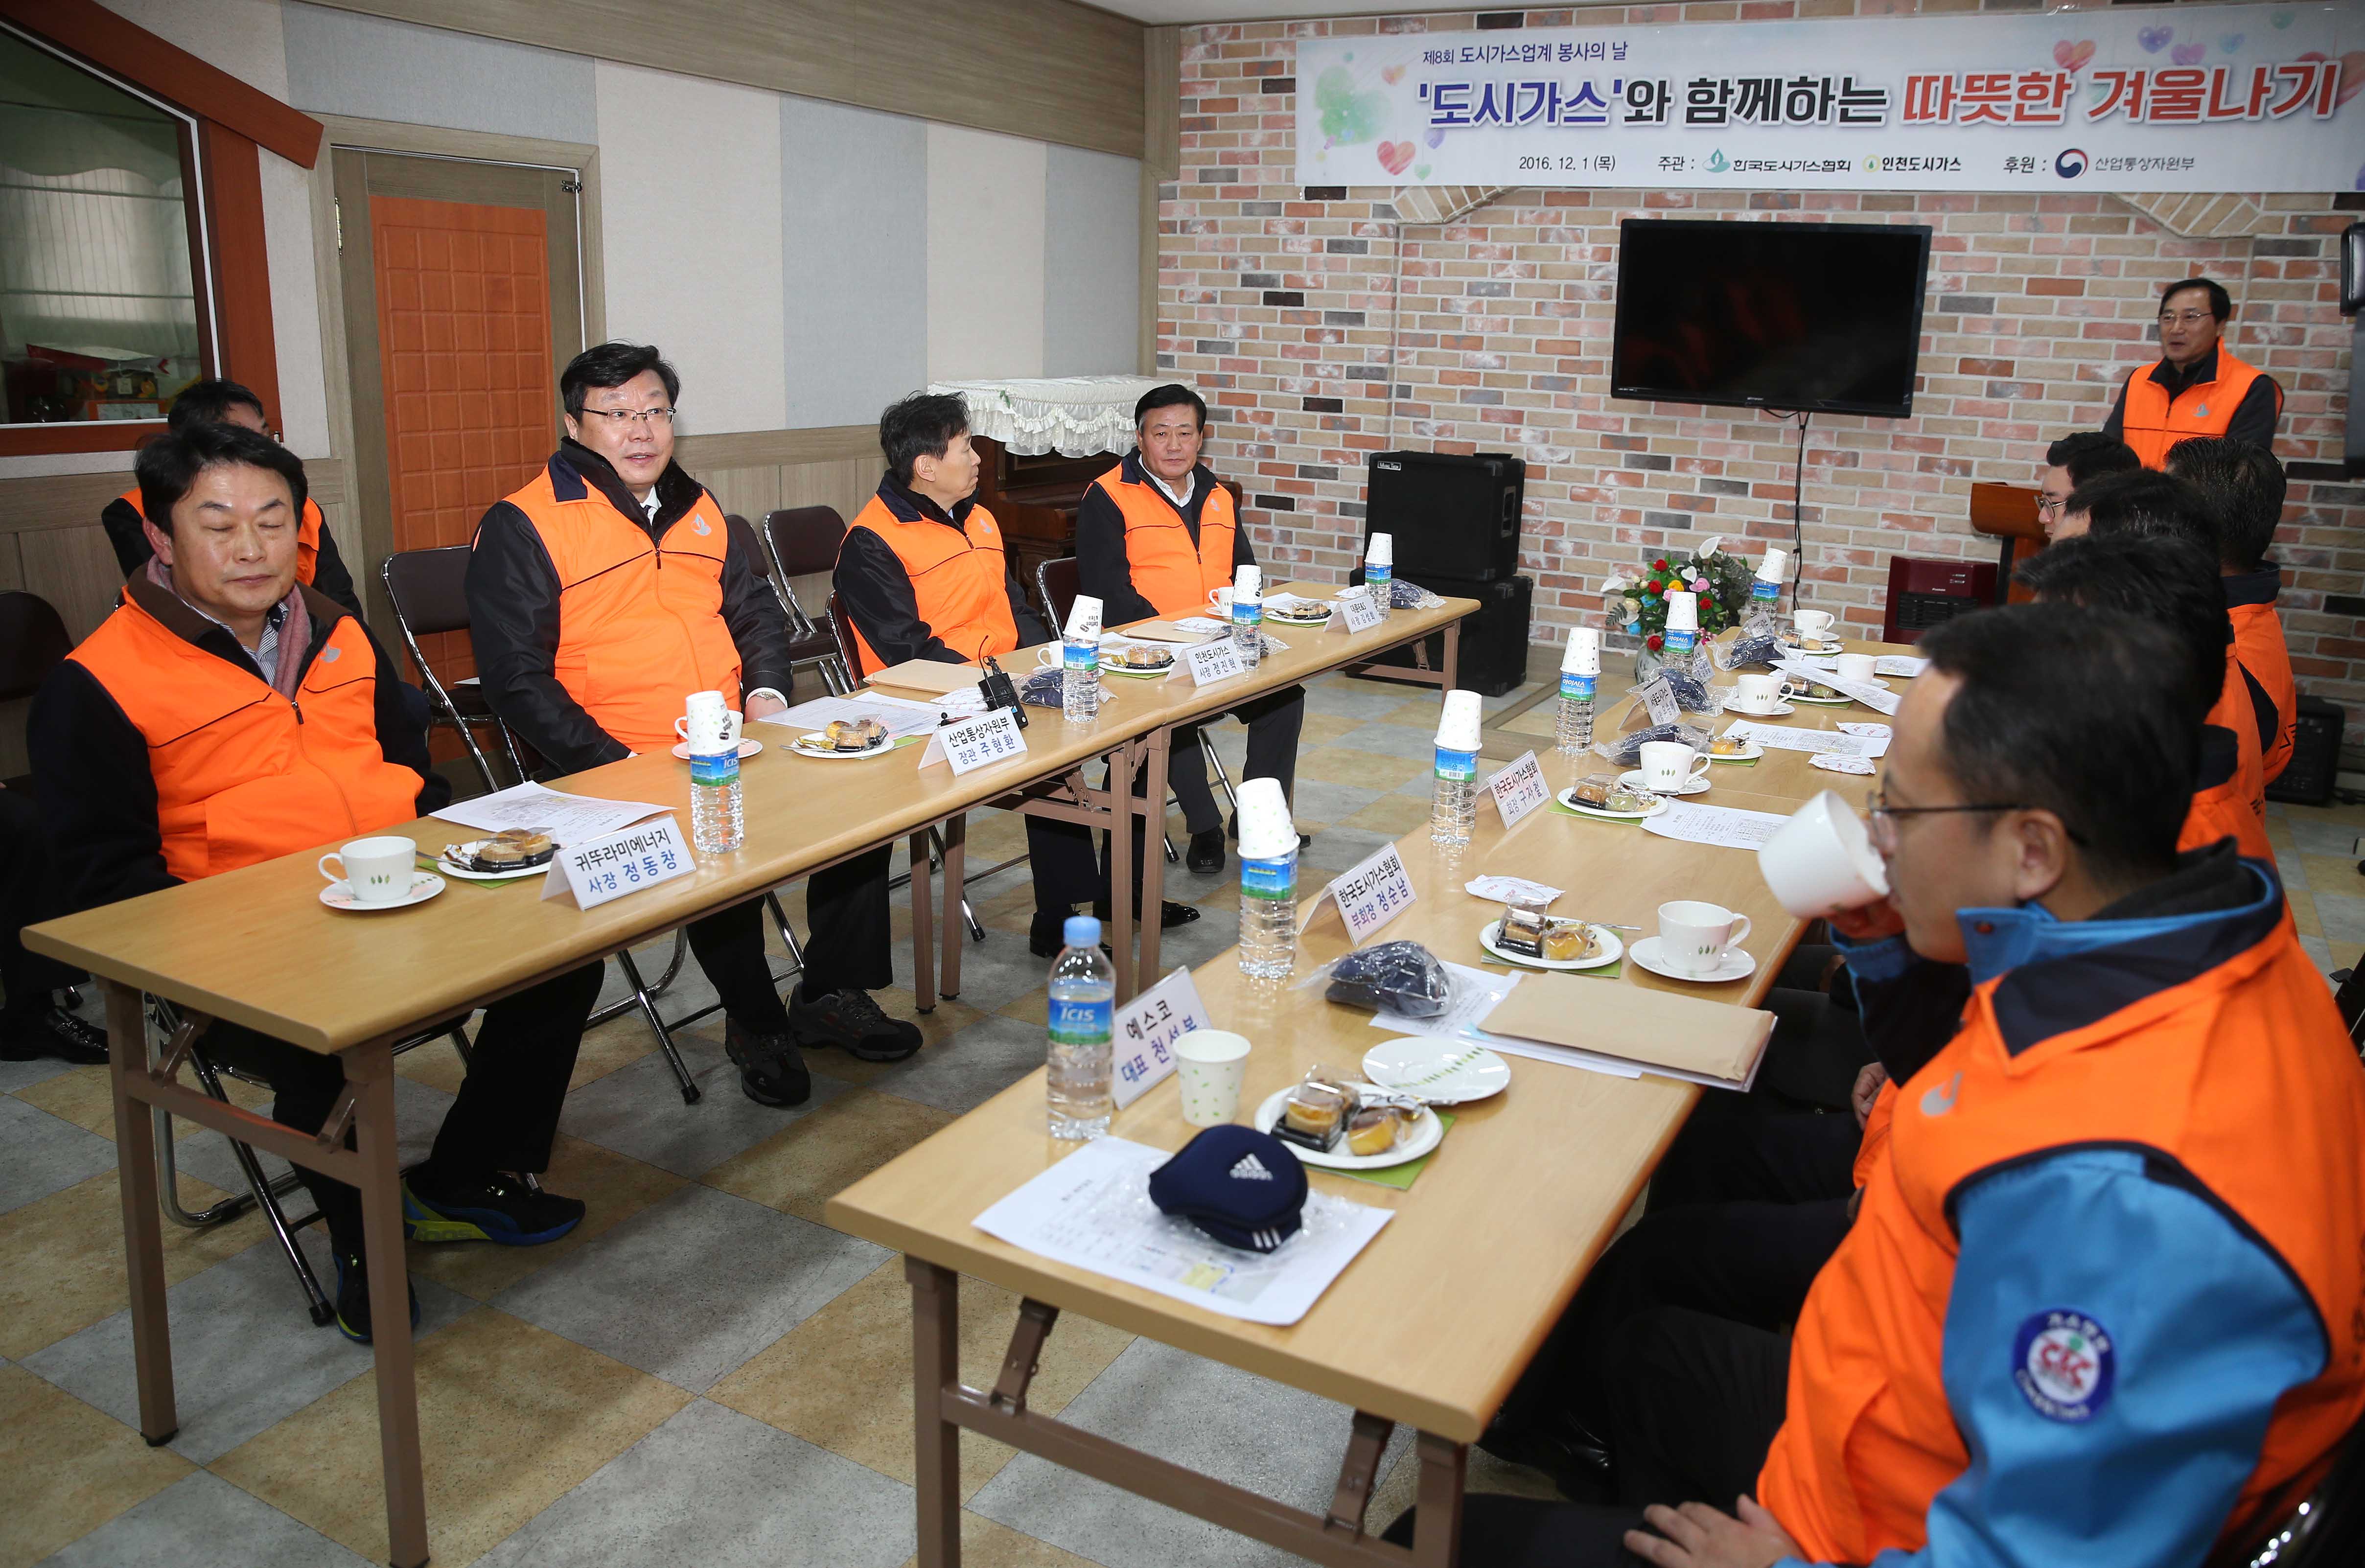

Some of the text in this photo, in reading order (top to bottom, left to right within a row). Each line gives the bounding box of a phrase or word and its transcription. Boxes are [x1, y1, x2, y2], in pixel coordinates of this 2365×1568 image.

[1422, 41, 1628, 65] 제8회 도시가스업계 봉사의 날
[1686, 76, 1887, 123] 함께하는
[1903, 71, 2072, 122] 따뜻한
[2087, 64, 2337, 120] 겨울나기
[1519, 156, 1553, 170] 2016.
[1558, 156, 1577, 171] 12.
[1593, 155, 1616, 172] (목)
[1733, 159, 1852, 172] 한국도시가스협회
[1881, 156, 1962, 172] 인천도시가스
[2094, 156, 2195, 172] 산업통상자원부
[1195, 646, 1230, 664] 인천도시가스
[1199, 666, 1211, 678] 사장
[1649, 687, 1669, 707] 서울도시가스
[949, 716, 1010, 748] 산업통상자원부
[958, 748, 978, 764] 장관
[1494, 760, 1539, 799] 한국도시가스협회
[1507, 797, 1519, 815] 회장
[574, 828, 672, 872] 귀뚜라미에너지
[588, 872, 618, 893] 사장
[1339, 854, 1402, 908] 한국도시가스협회
[1351, 902, 1377, 930] 부회장
[1127, 1000, 1172, 1040] 예스코
[1121, 1054, 1149, 1083] 대표
